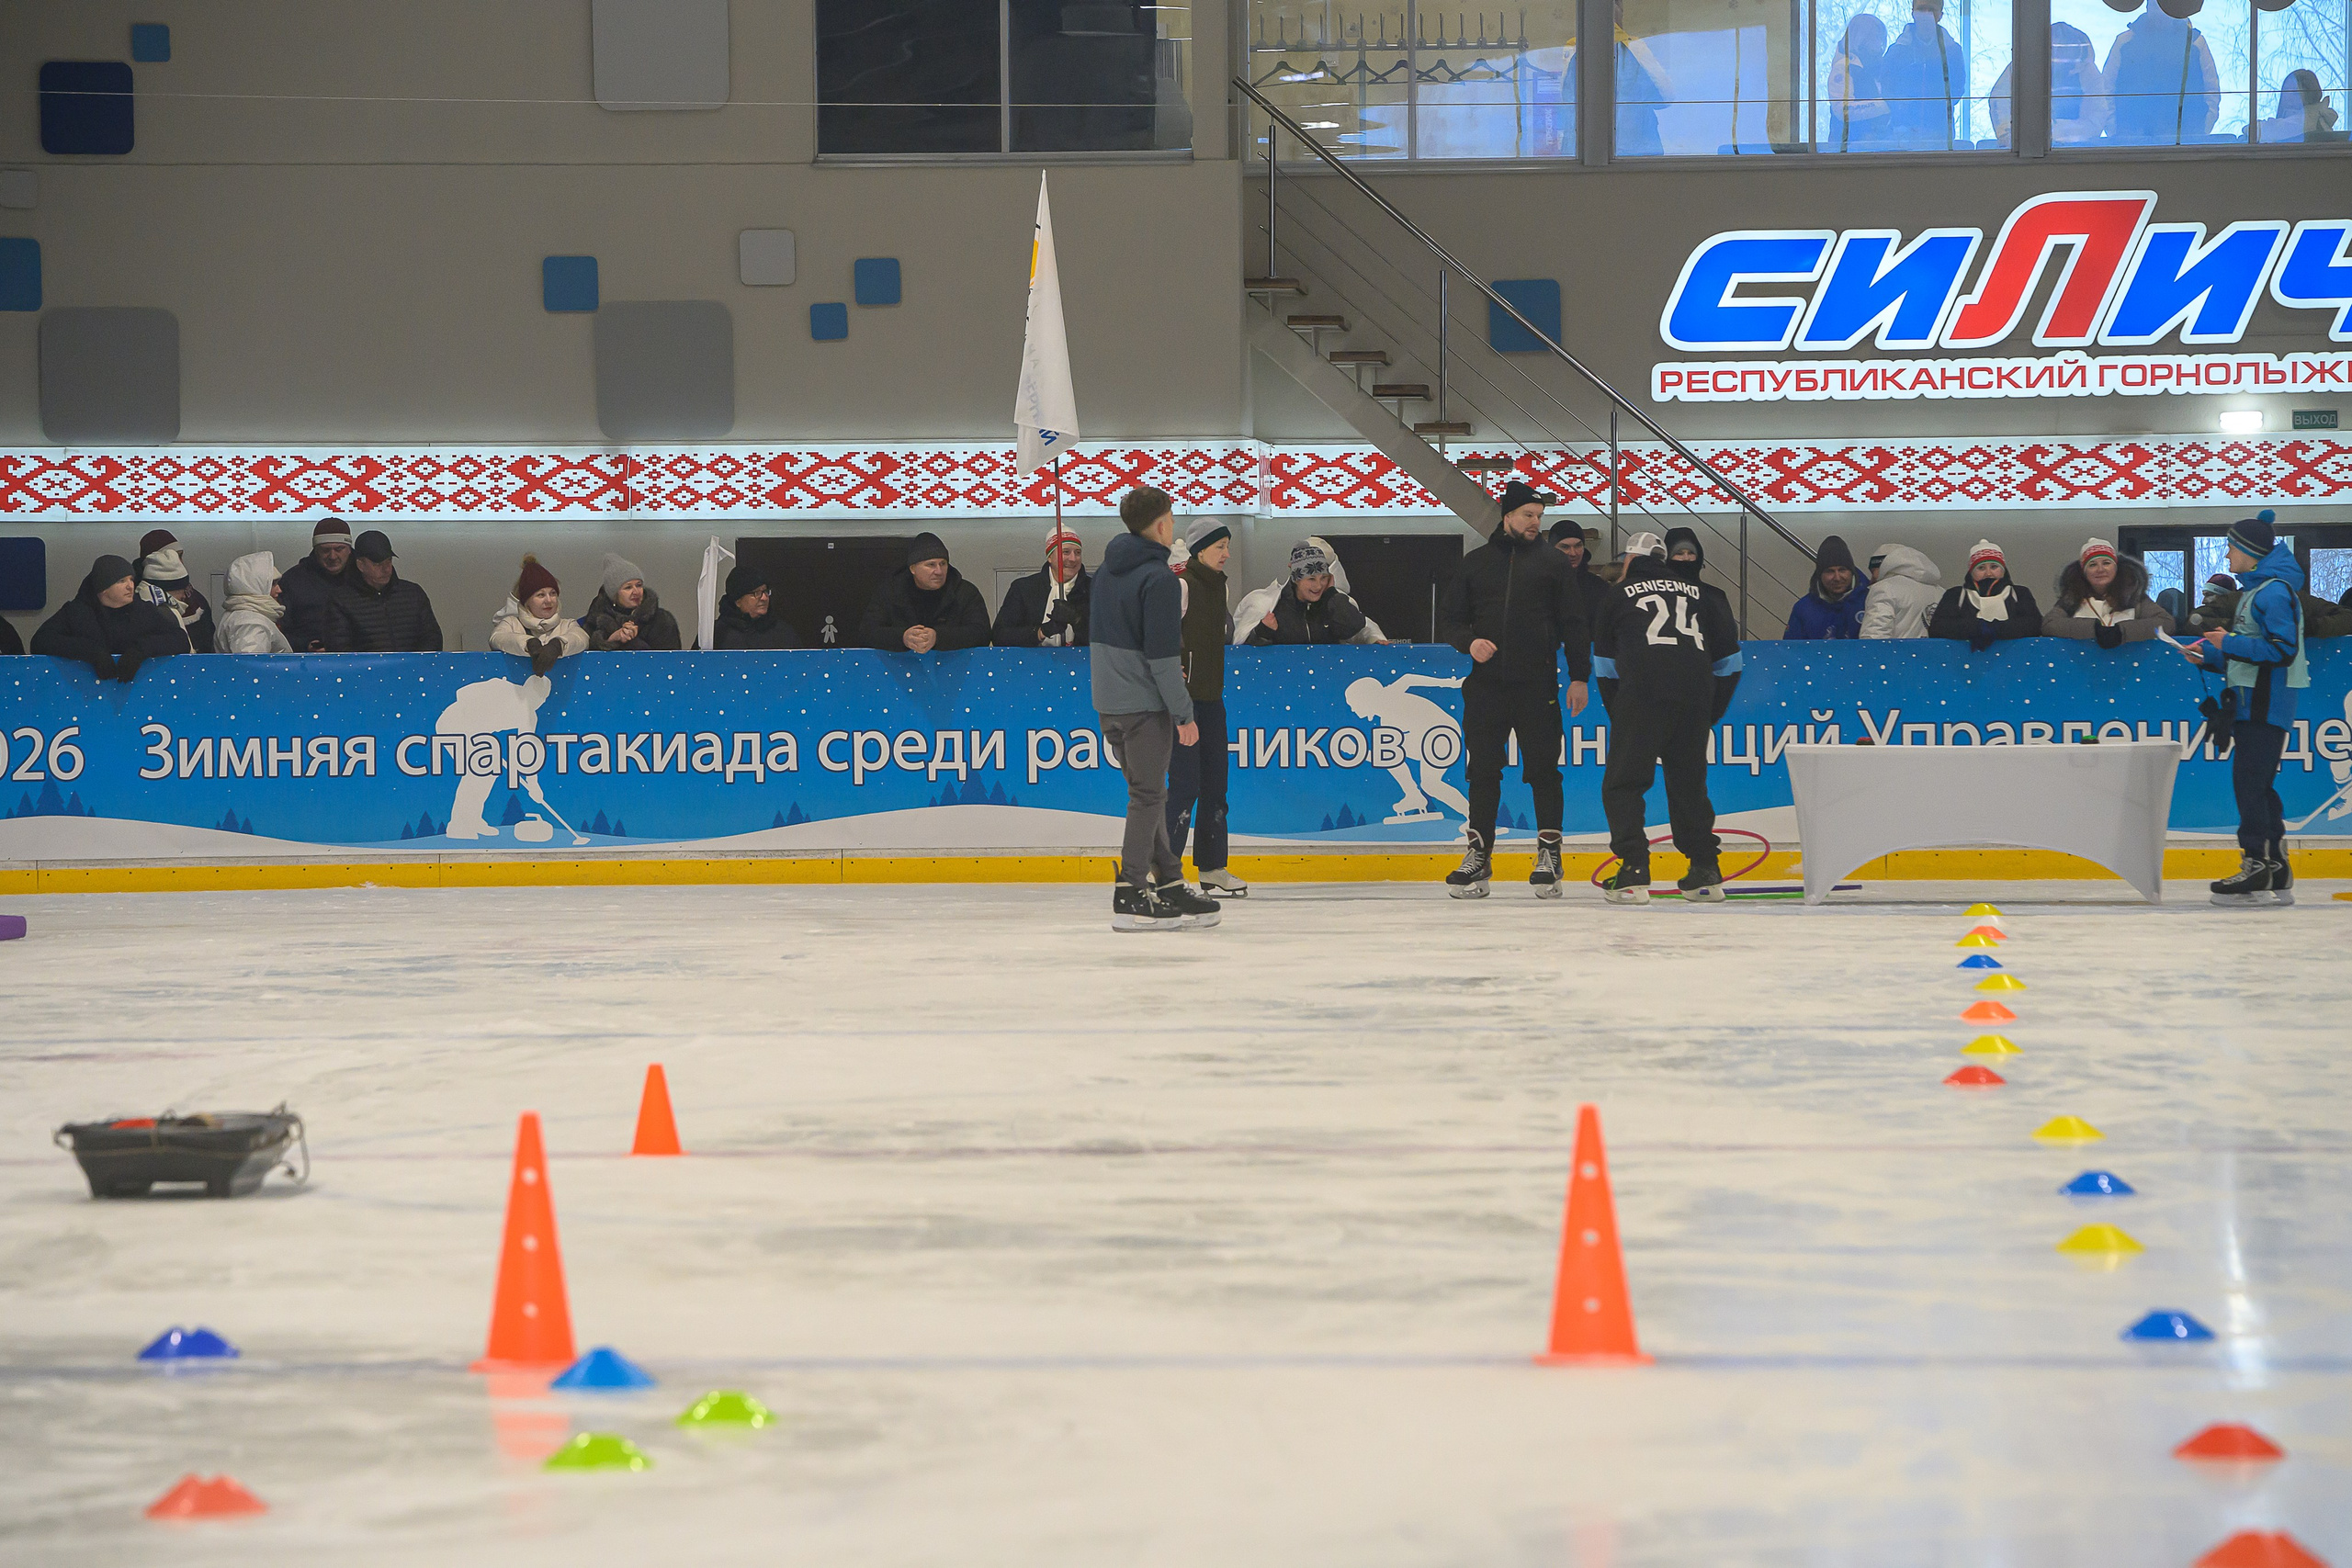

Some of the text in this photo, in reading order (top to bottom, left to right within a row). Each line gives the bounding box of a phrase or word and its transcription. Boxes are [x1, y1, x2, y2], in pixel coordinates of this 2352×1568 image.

[1660, 358, 2352, 394] РЕСПУБЛИКАНСКИЙ ГОРНОЛЫЖ
[2294, 414, 2337, 426] ВЫХОД
[1623, 580, 1700, 600] DENISENKO
[1635, 594, 1704, 651] 24
[0, 726, 85, 782] 26
[139, 723, 377, 780] Зимняя
[395, 729, 798, 789] спартакиада
[817, 728, 1006, 785] среди
[1026, 726, 1406, 784] раников
[1856, 708, 2235, 761] Упавлени
